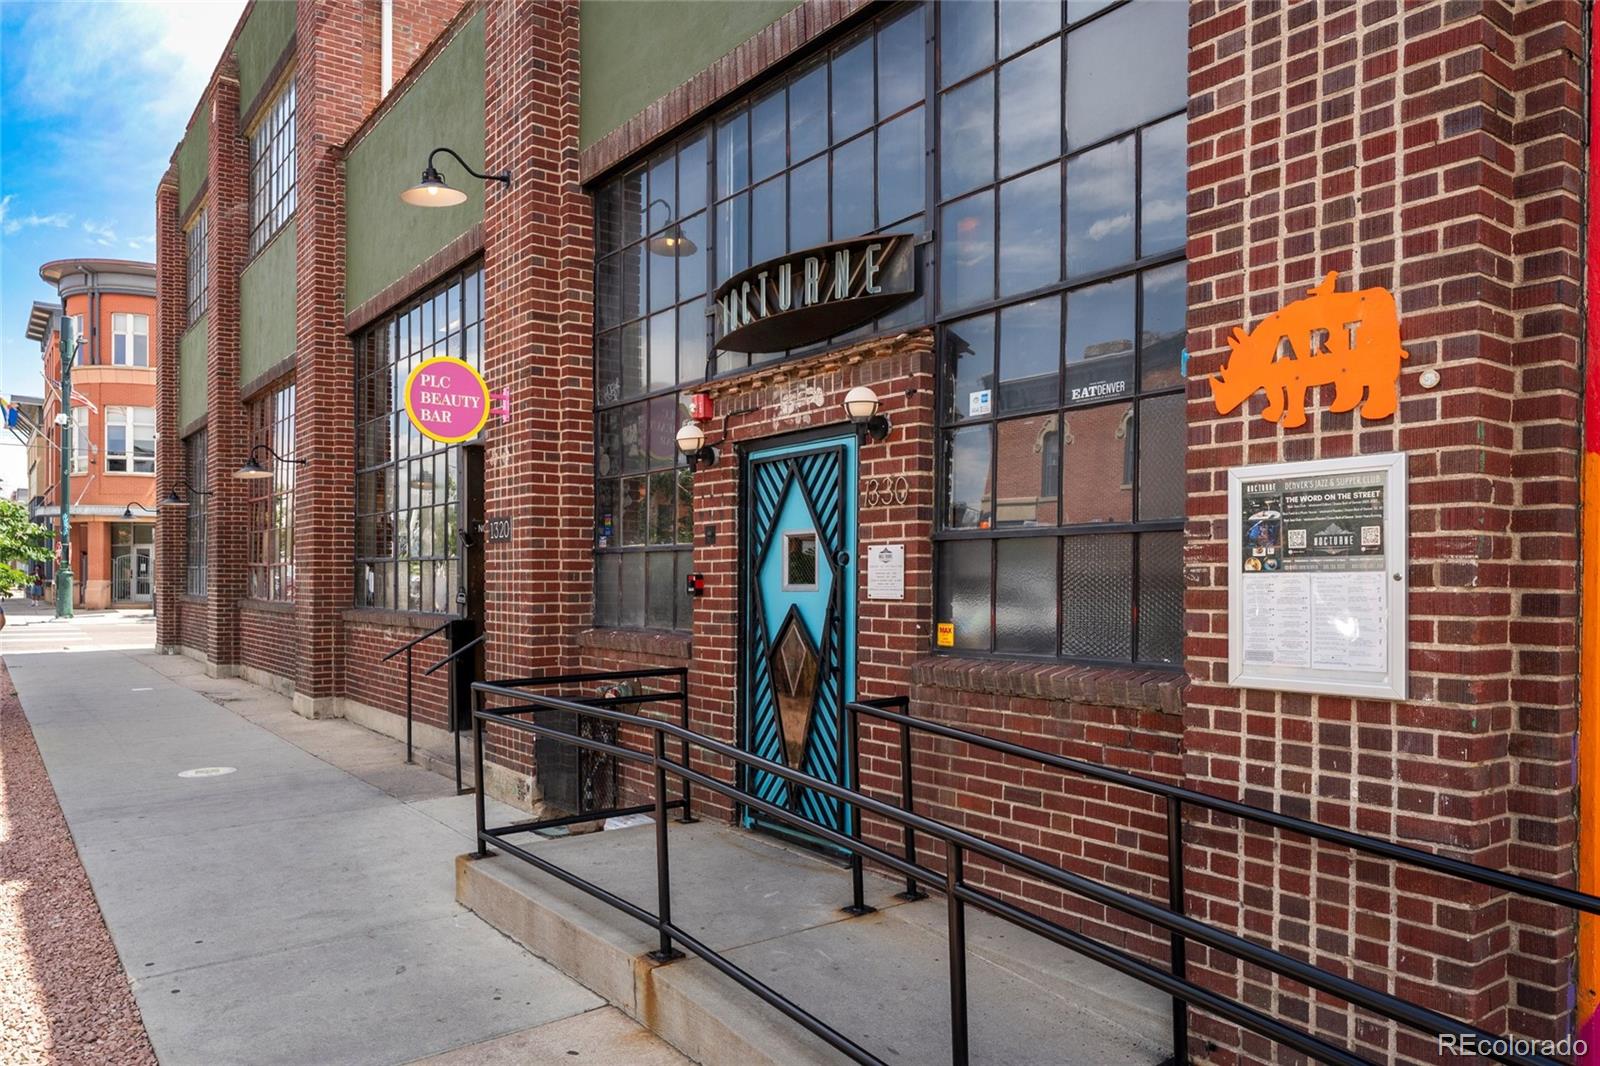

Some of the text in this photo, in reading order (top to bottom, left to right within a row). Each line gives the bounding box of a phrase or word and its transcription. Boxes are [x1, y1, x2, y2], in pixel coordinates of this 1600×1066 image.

[1270, 319, 1363, 364] ART
[421, 374, 451, 389] PLC
[421, 391, 481, 409] BEAUTY
[421, 408, 453, 424] BAR
[864, 476, 908, 507] 1330
[1285, 496, 1299, 504] THE
[1299, 494, 1323, 503] WORD
[1323, 493, 1336, 501] ON
[1337, 492, 1352, 500] THE
[1353, 490, 1381, 499] STREET
[490, 520, 510, 539] 1320
